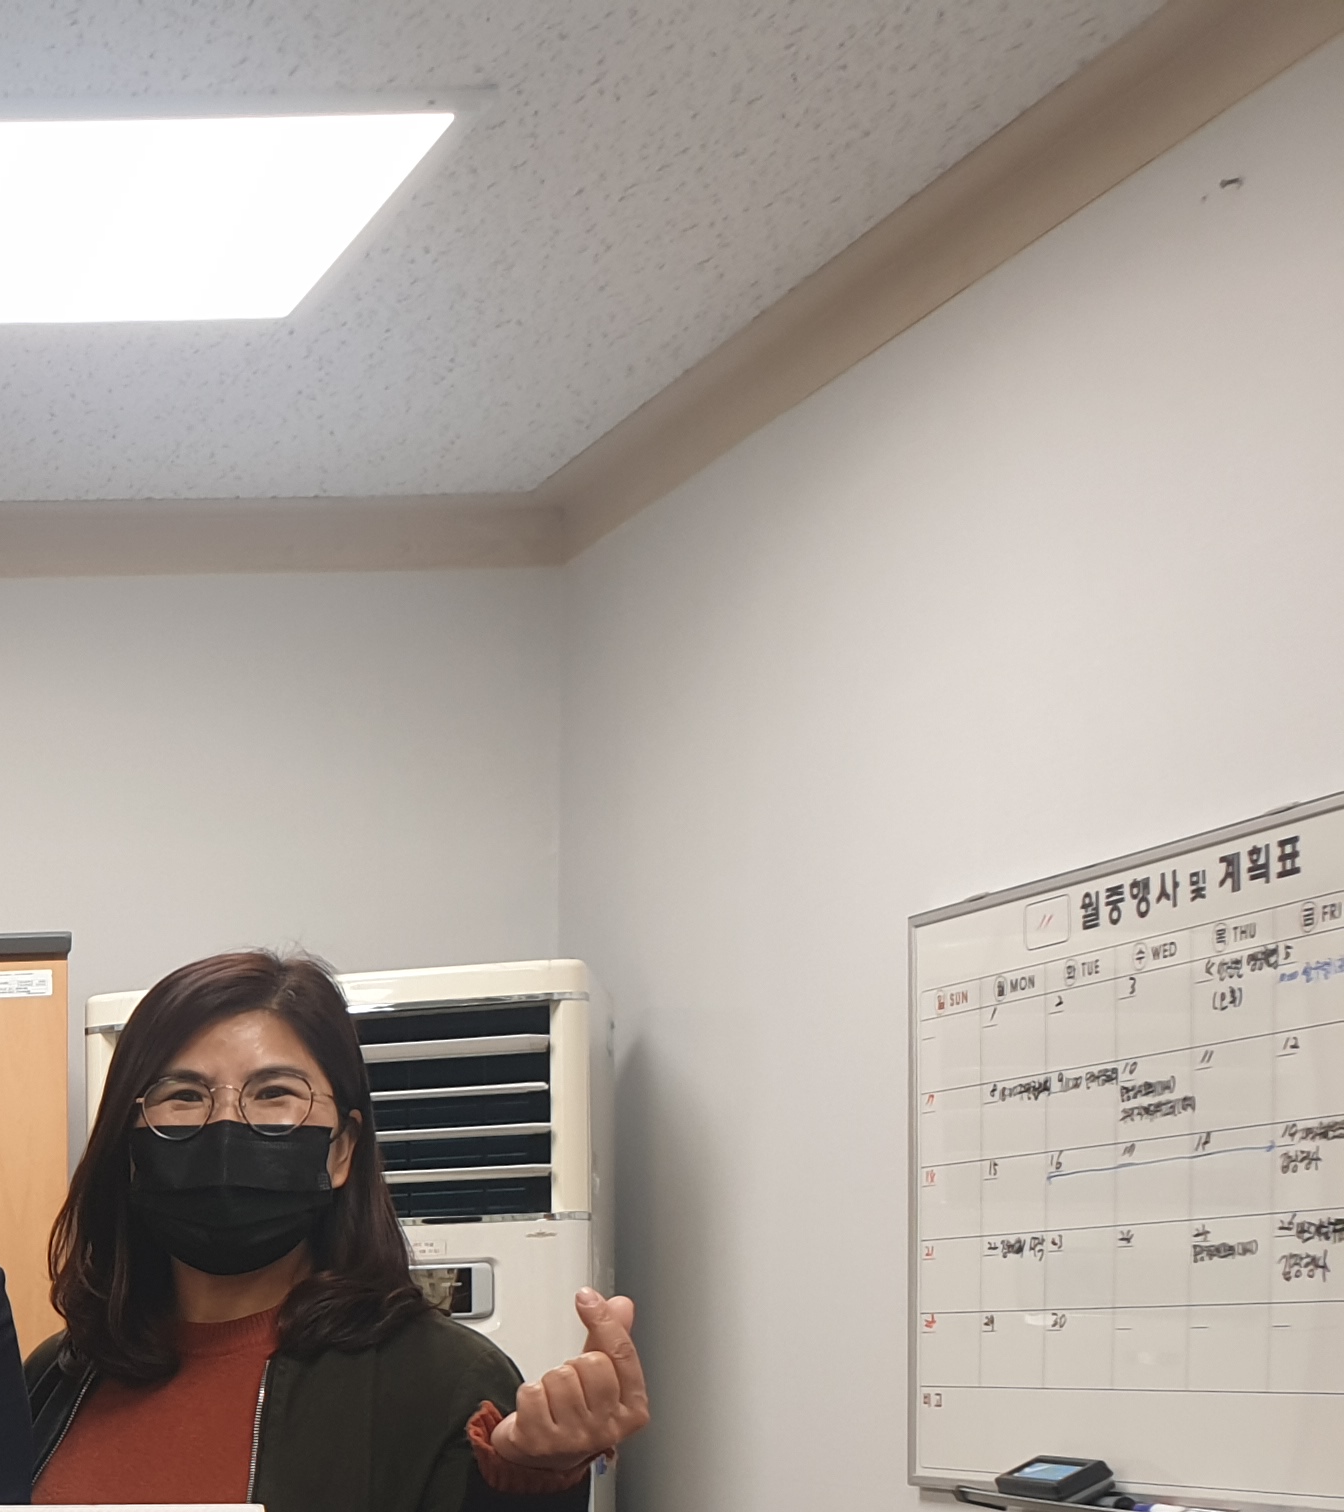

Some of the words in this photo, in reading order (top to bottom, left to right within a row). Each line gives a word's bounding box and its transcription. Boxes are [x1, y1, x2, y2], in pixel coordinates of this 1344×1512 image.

[1080, 868, 1180, 931] 월중행사
[1189, 869, 1207, 902] 및
[1218, 834, 1302, 893] 계획표
[1321, 901, 1344, 922] FRI
[1232, 922, 1257, 943] THU
[1151, 941, 1178, 961] WED
[1283, 944, 1294, 961] 5
[1080, 959, 1100, 977] TUE
[1010, 975, 1036, 993] MON
[1128, 976, 1137, 995] 3
[949, 991, 969, 1006] SUN
[1282, 1037, 1300, 1050] 12
[1200, 1050, 1214, 1064] 11
[1121, 1061, 1138, 1075] 10
[989, 1160, 999, 1176] 15
[1049, 1150, 1063, 1171] 16
[1050, 1312, 1067, 1328] 30
